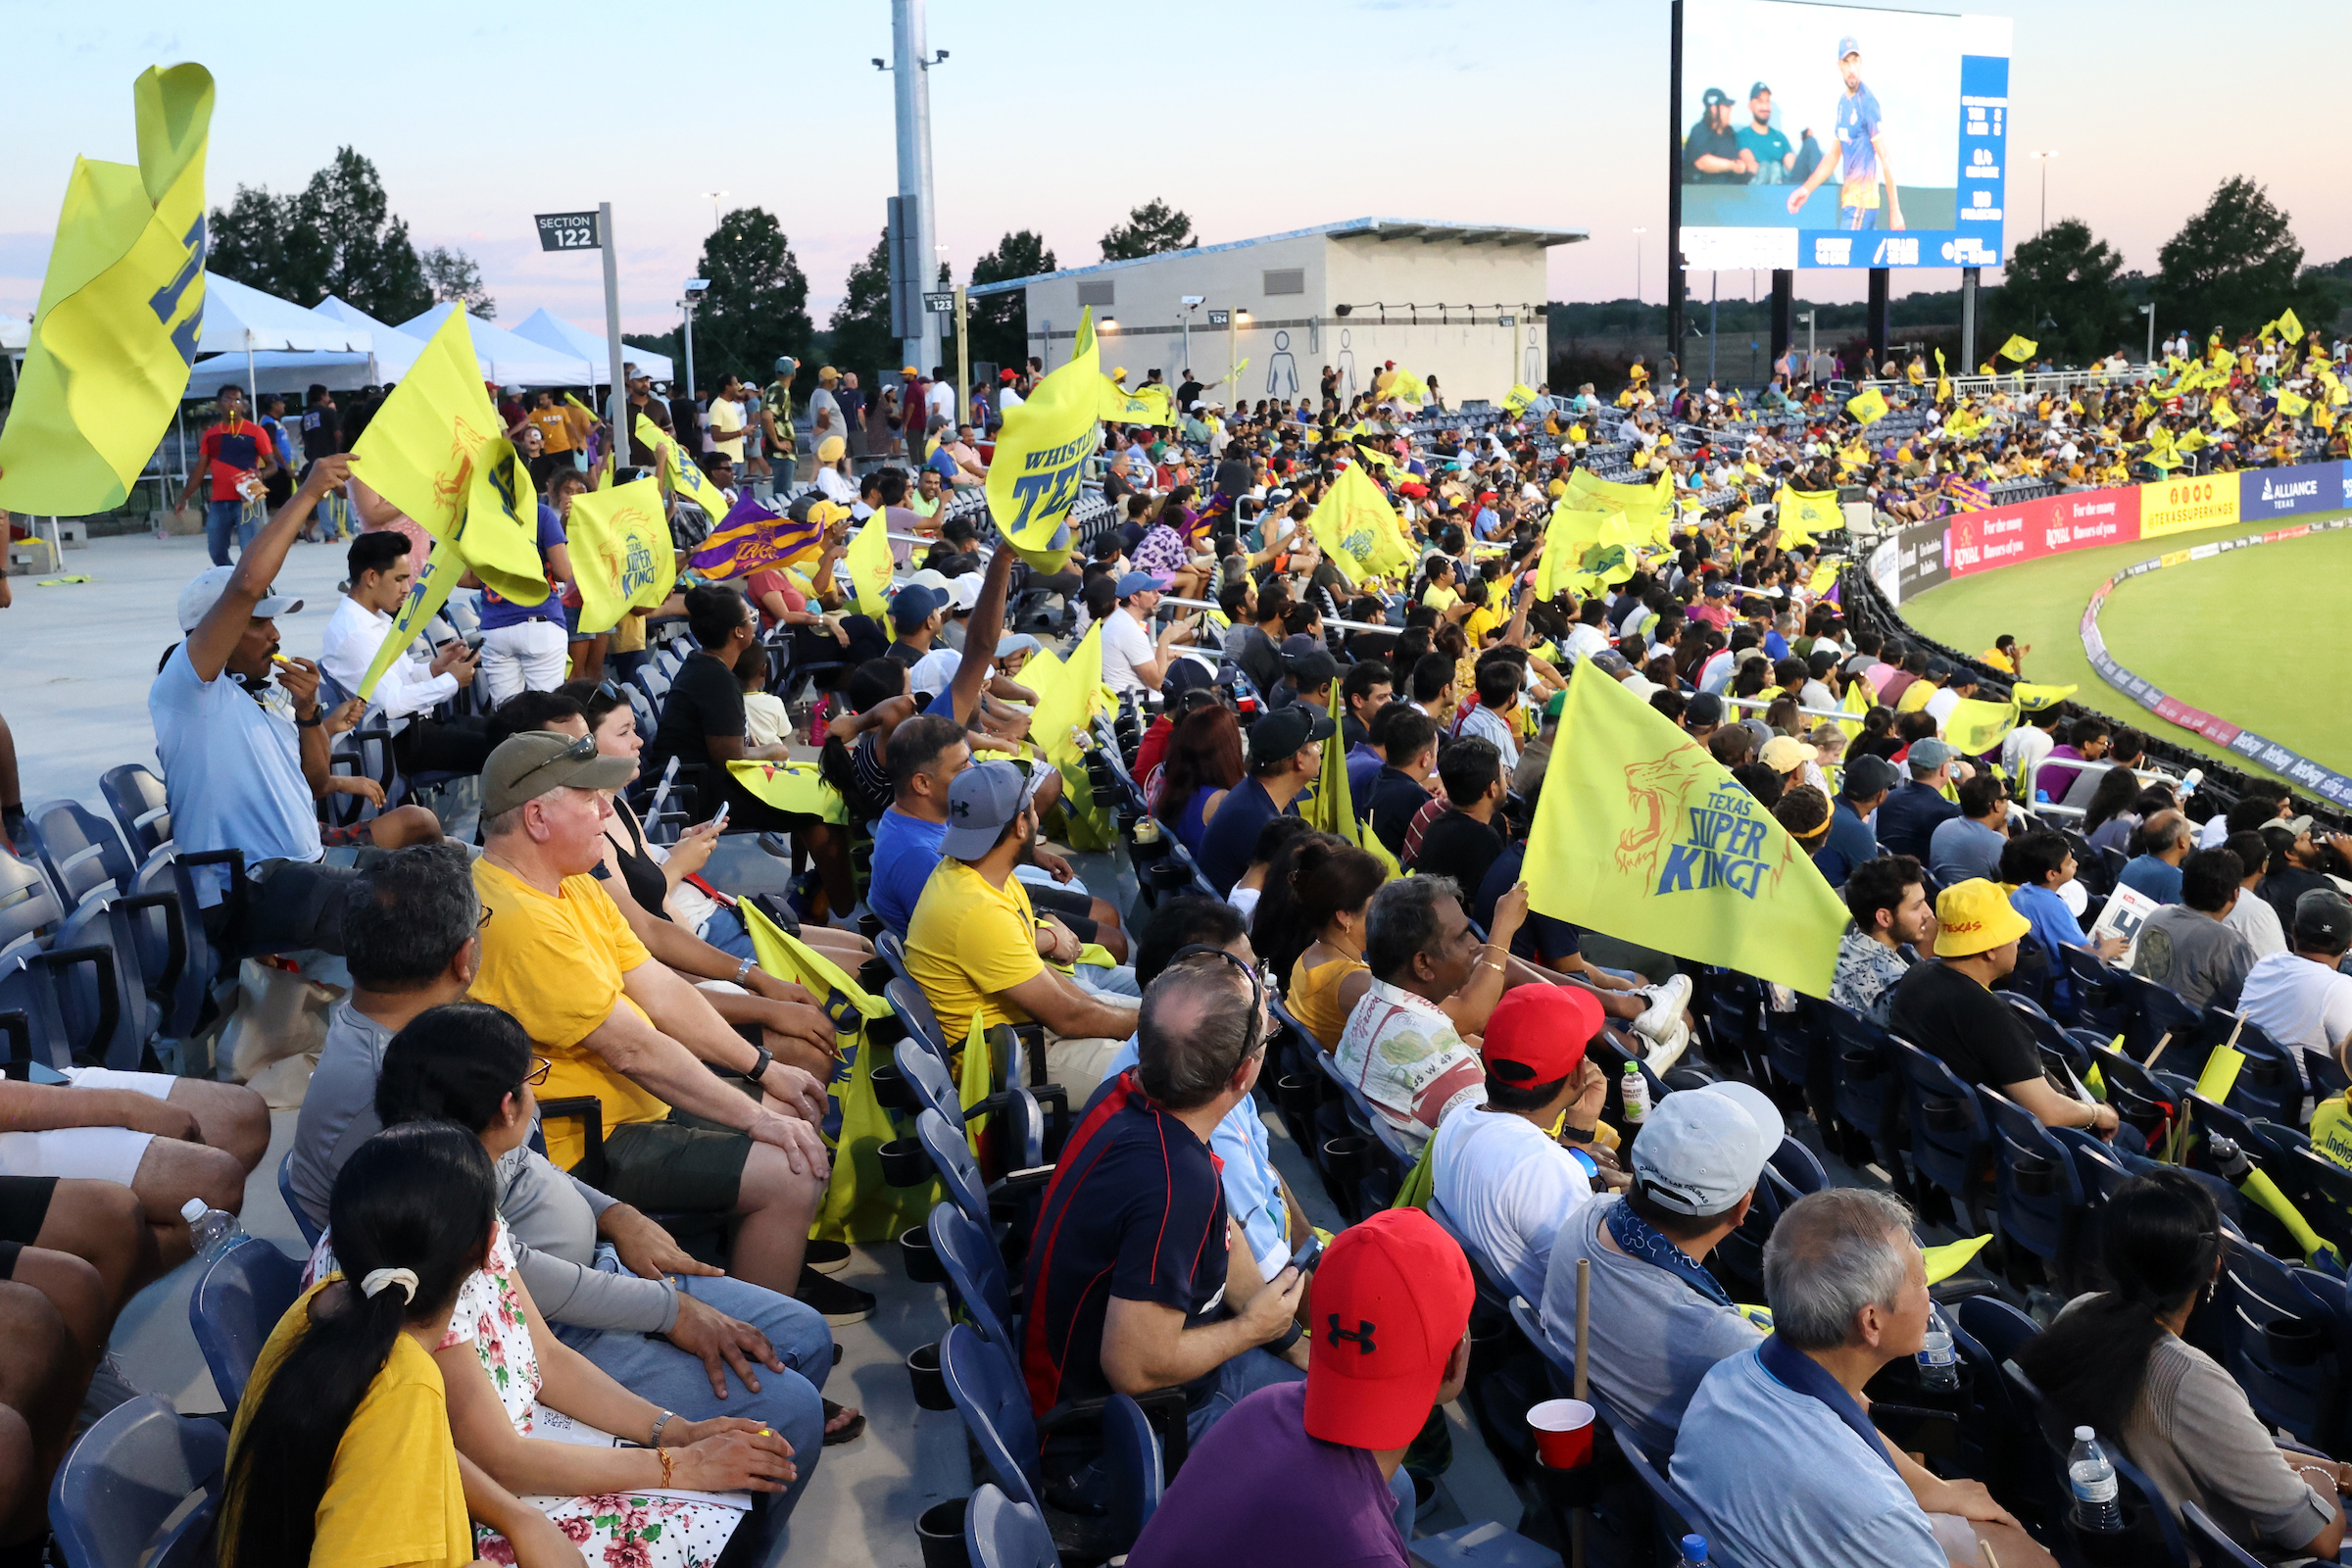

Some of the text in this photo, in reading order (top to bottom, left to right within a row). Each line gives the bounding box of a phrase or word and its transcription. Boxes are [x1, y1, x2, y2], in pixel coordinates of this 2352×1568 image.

[539, 216, 591, 228] SECTION
[554, 228, 592, 247] 122
[933, 300, 953, 311] 123
[2274, 480, 2318, 499] ALLIANCE
[2074, 503, 2084, 518] For
[2085, 502, 2095, 515] the
[2274, 499, 2294, 510] TEXAS
[1984, 519, 1995, 536] For
[2147, 503, 2233, 530] @TEXASSUPERKINGS
[2046, 526, 2071, 550] ROYAL
[2074, 524, 2096, 540] flavors
[2103, 523, 2117, 538] you
[625, 549, 652, 573] SUPER
[1954, 545, 1980, 570] ROYAL
[1984, 542, 2005, 560] flavors
[621, 565, 655, 603] KINGS
[2232, 730, 2264, 758] betway
[2262, 744, 2293, 771] betway
[2290, 759, 2327, 788] betway
[1708, 792, 1754, 816] TEXAS
[1688, 807, 1767, 860] SUPER
[1653, 843, 1771, 900] KINGS
[1942, 921, 1982, 933] TEXAS
[1684, 1184, 1709, 1204] COLINAS
